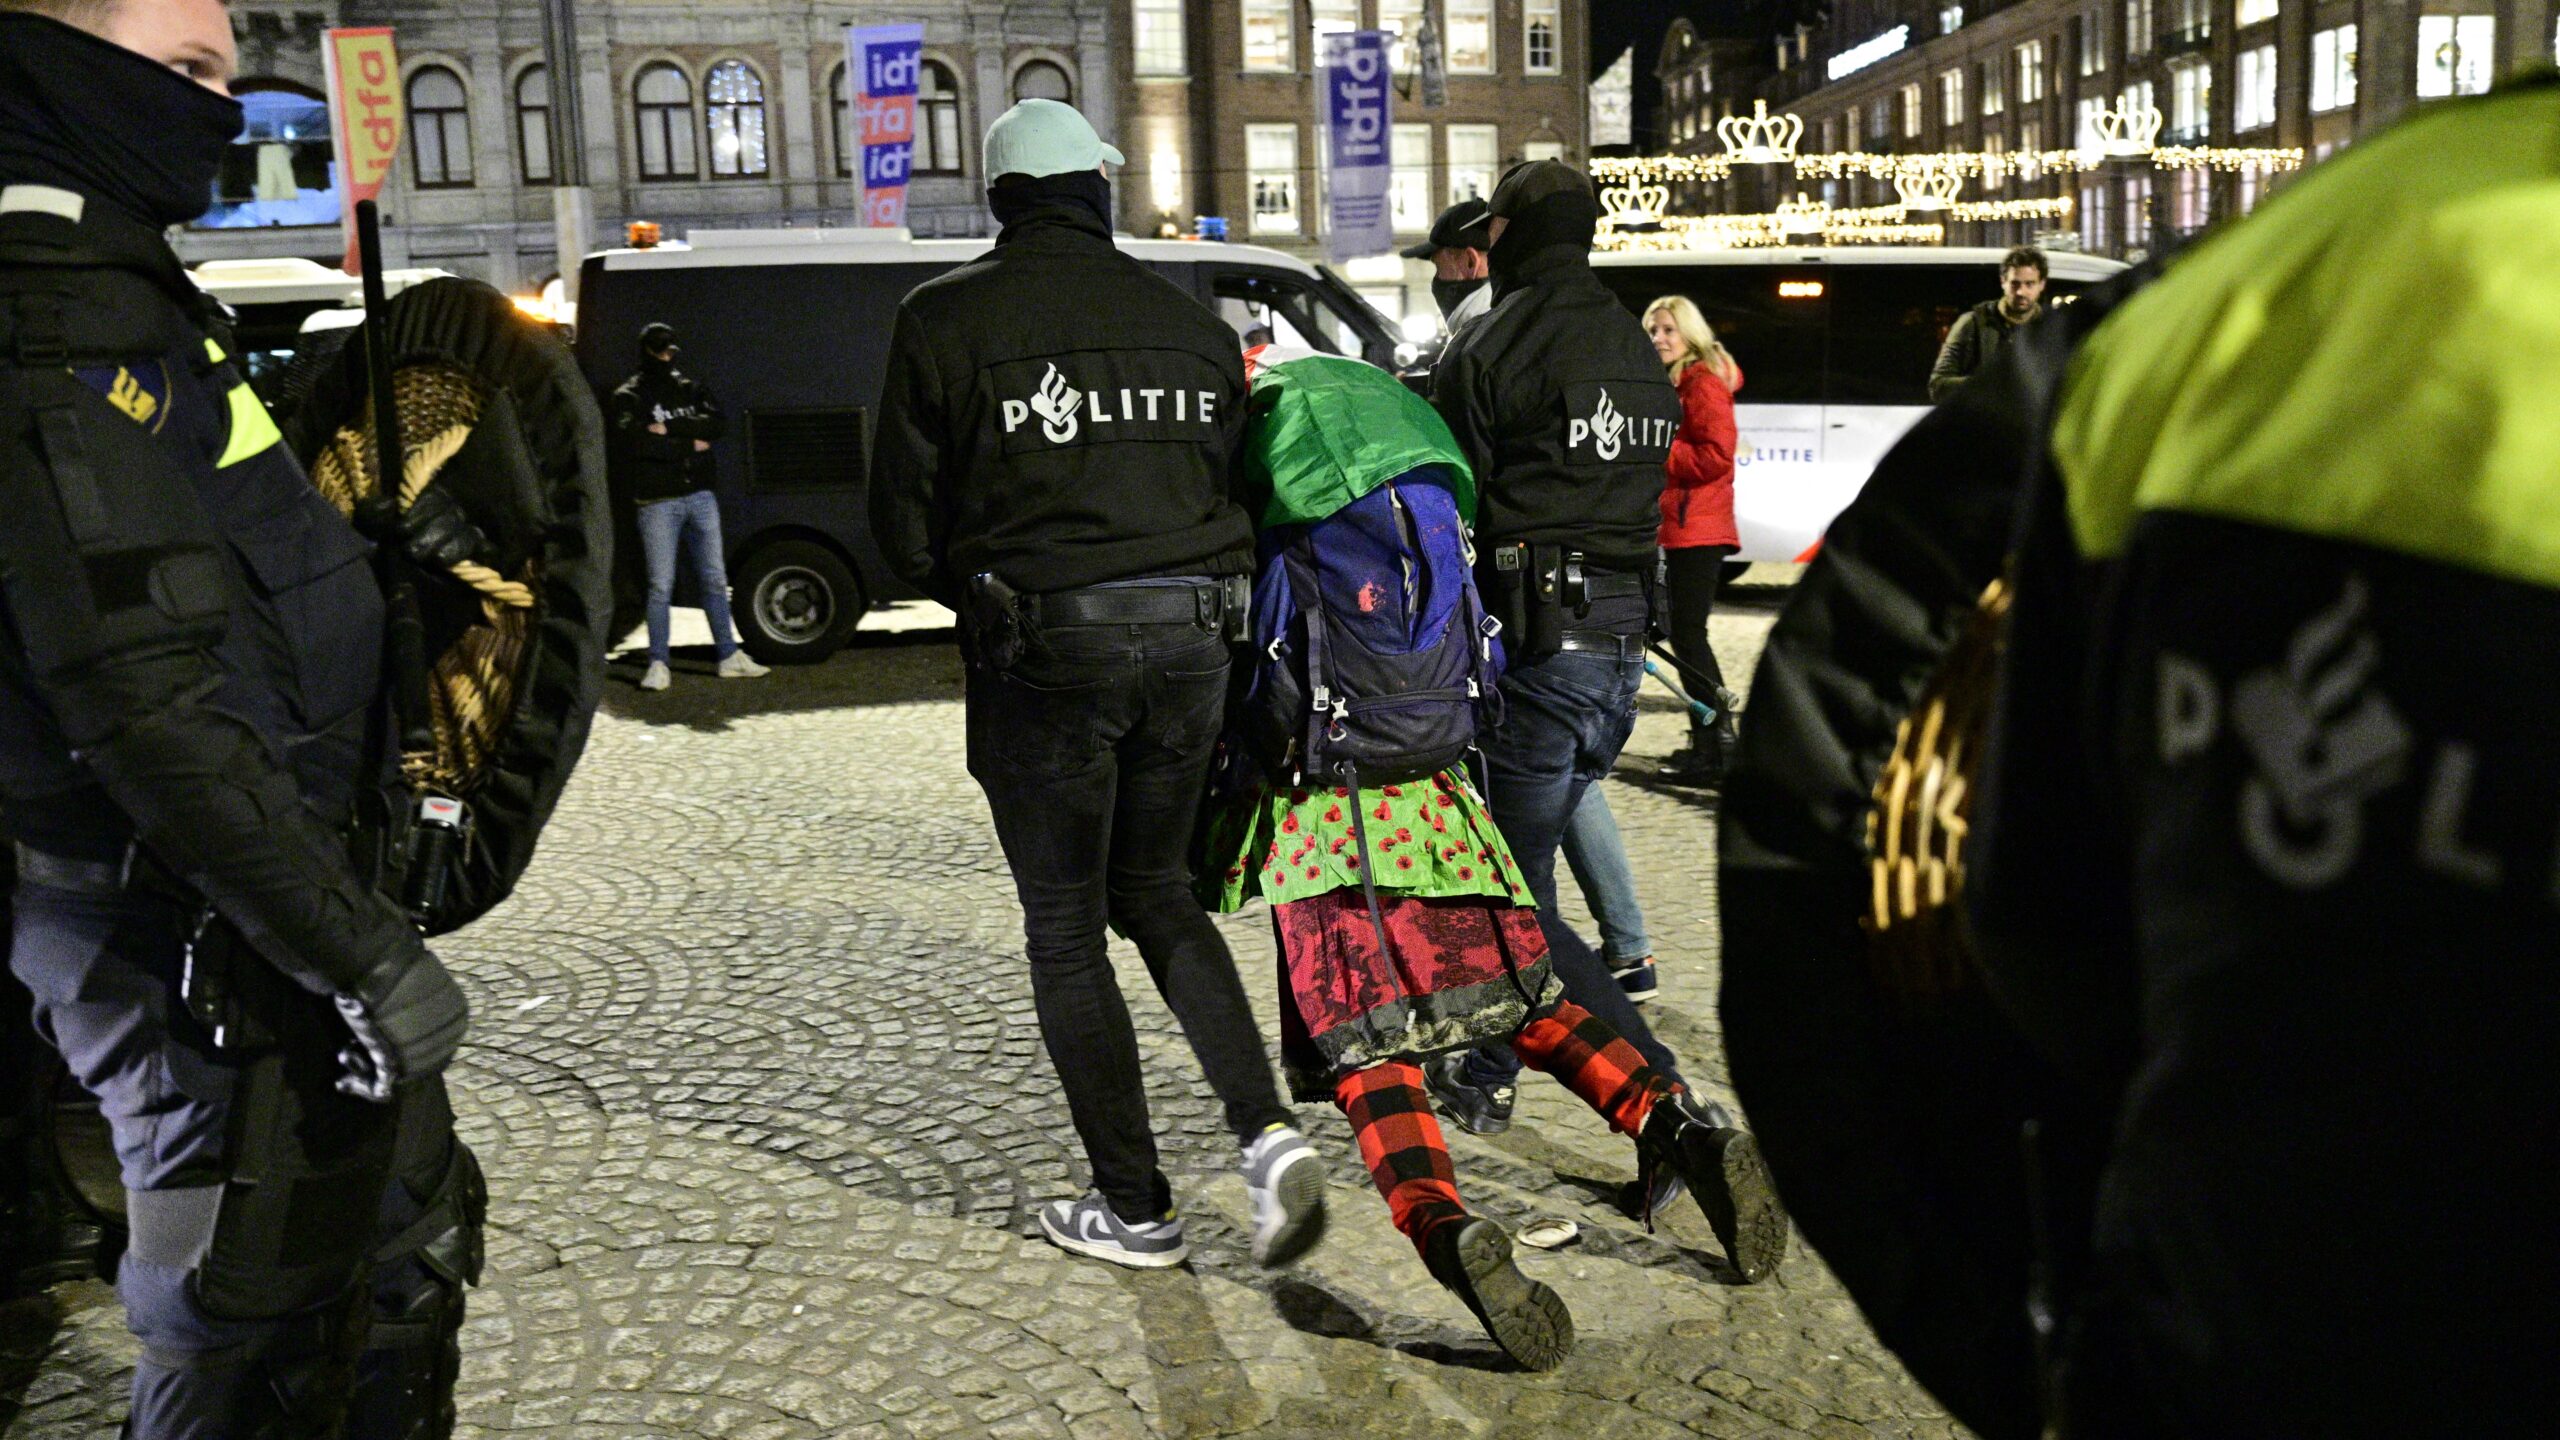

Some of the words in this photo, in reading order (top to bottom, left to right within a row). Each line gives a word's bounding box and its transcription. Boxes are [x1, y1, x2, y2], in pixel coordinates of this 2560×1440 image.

[355, 51, 397, 169] idfa
[1340, 48, 1381, 156] idfa
[1002, 384, 1216, 443] POLITIE
[1568, 413, 1680, 460] POLITI
[1737, 445, 1814, 467] OLITIE
